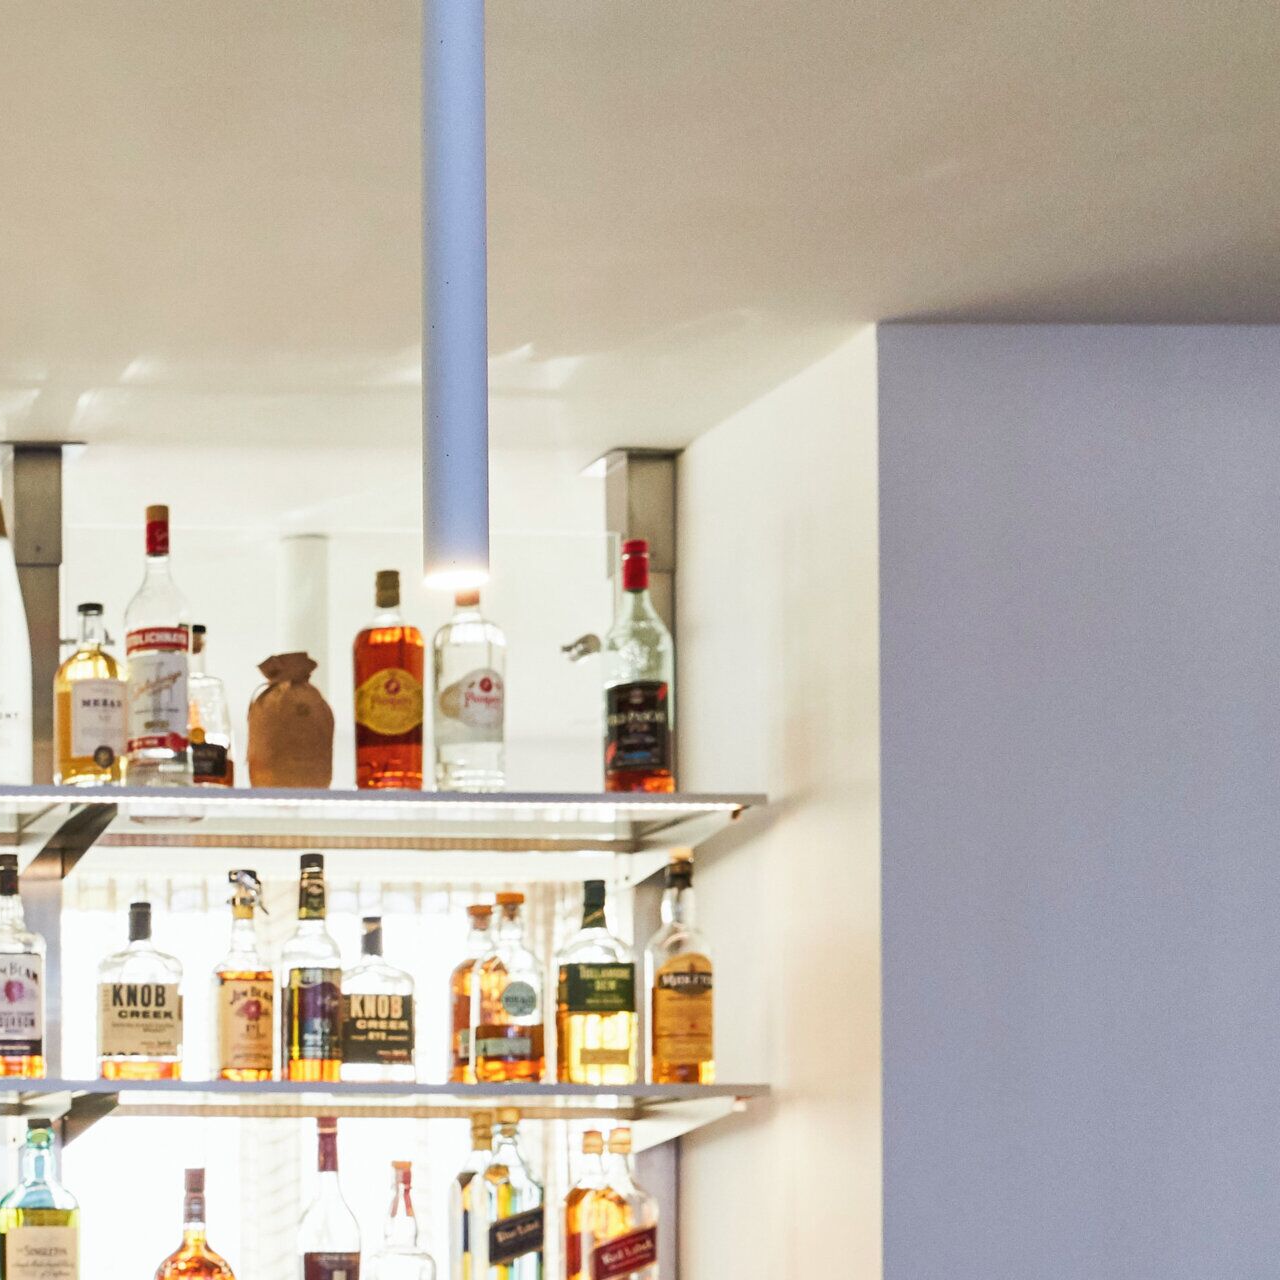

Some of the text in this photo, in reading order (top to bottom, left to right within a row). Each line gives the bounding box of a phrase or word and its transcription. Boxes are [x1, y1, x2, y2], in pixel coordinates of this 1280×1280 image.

[111, 984, 166, 1007] KNOB
[350, 995, 403, 1018] KNOB
[117, 1010, 173, 1019] CREEK
